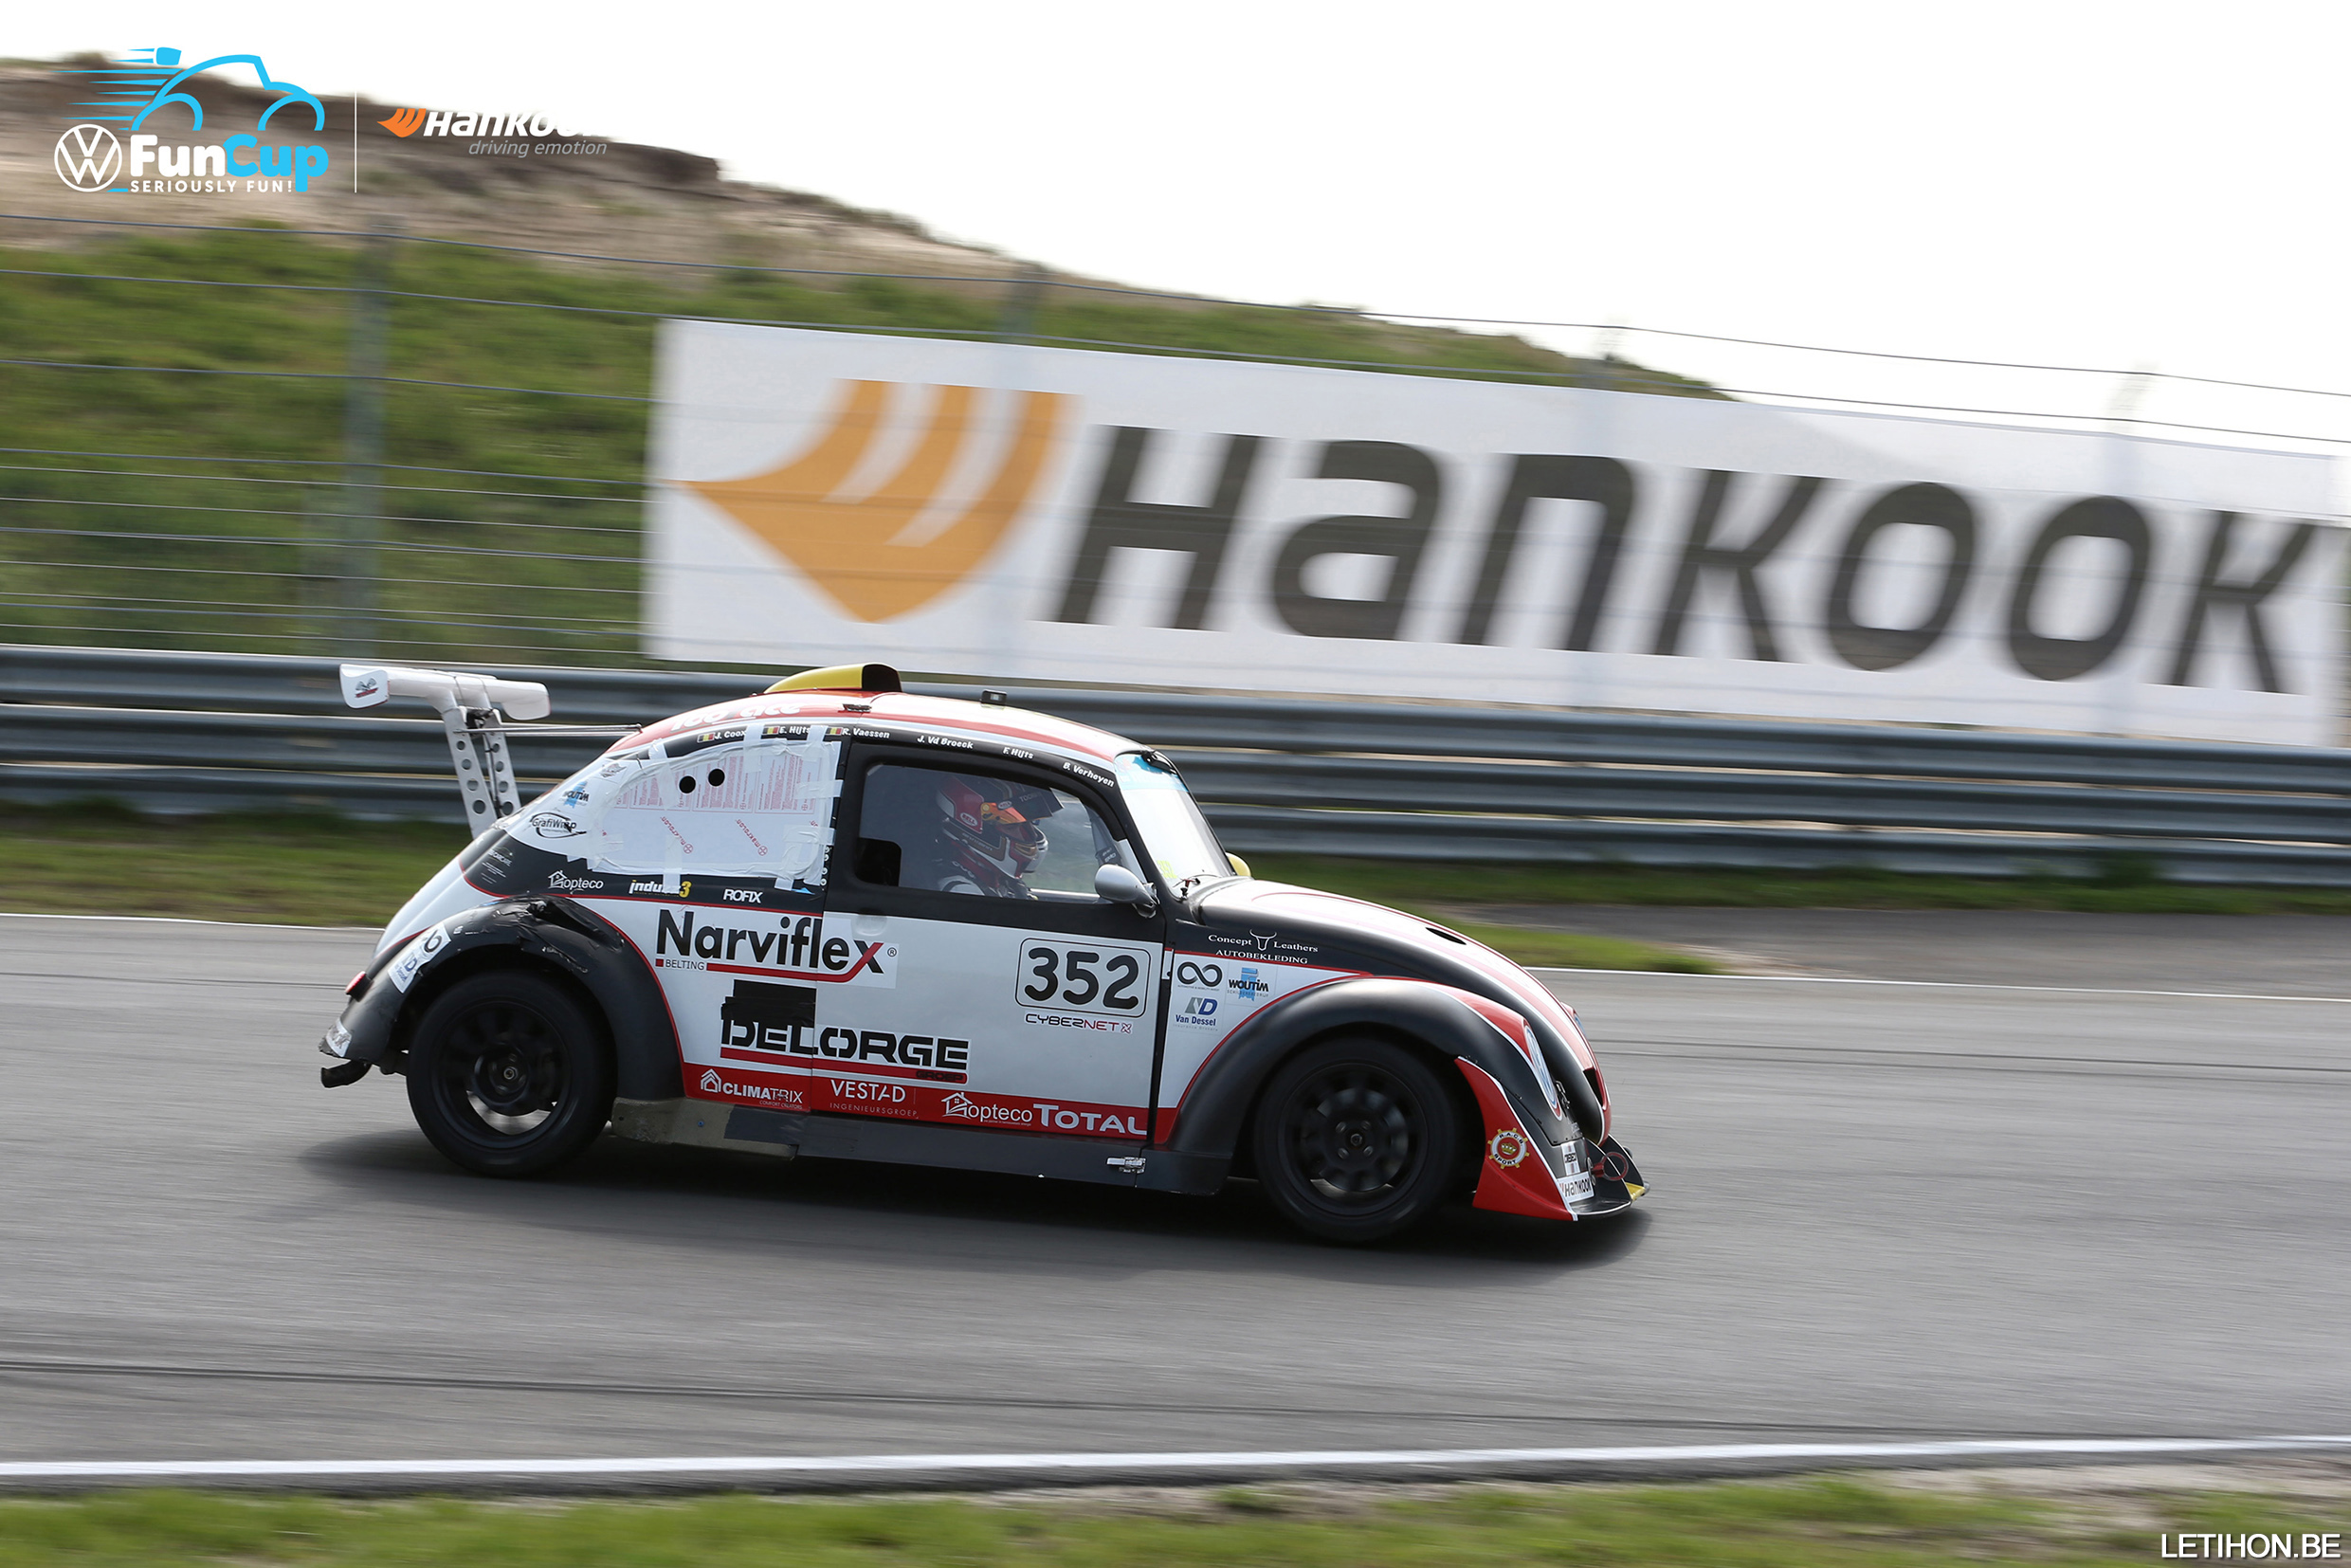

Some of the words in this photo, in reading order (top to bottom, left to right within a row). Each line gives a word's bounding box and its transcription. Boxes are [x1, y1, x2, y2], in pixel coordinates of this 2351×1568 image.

[714, 731, 722, 739] J.
[778, 726, 787, 735] E.
[841, 727, 850, 736] R.
[852, 728, 890, 739] Vaessen
[927, 736, 939, 745] Vd
[940, 737, 974, 749] Broeck
[1002, 746, 1011, 755] F.
[1063, 761, 1072, 771] B.
[1073, 764, 1115, 788] Verheyen
[736, 818, 761, 848] makrolon
[564, 877, 604, 890] opteco
[723, 888, 763, 903] ROFIX
[656, 909, 884, 975] Narviflex
[1208, 934, 1252, 946] Concept
[1273, 940, 1319, 953] Leathers
[665, 958, 705, 971] BELTING
[1215, 949, 1308, 965] AUTOBEKLEDING
[1024, 947, 1139, 1011] 352
[1176, 1013, 1188, 1024] Van
[1192, 1015, 1216, 1027] Dessel
[721, 1018, 969, 1070] DELORGE
[916, 1070, 963, 1082] GROEP
[722, 1082, 804, 1103] CLIMATRIX
[830, 1079, 906, 1103] VESTAD
[829, 1103, 917, 1117] INGENIEURSGROEP
[968, 1103, 1033, 1122] opteco
[1032, 1103, 1148, 1136] TOTAL
[1494, 1153, 1516, 1165] SPORT
